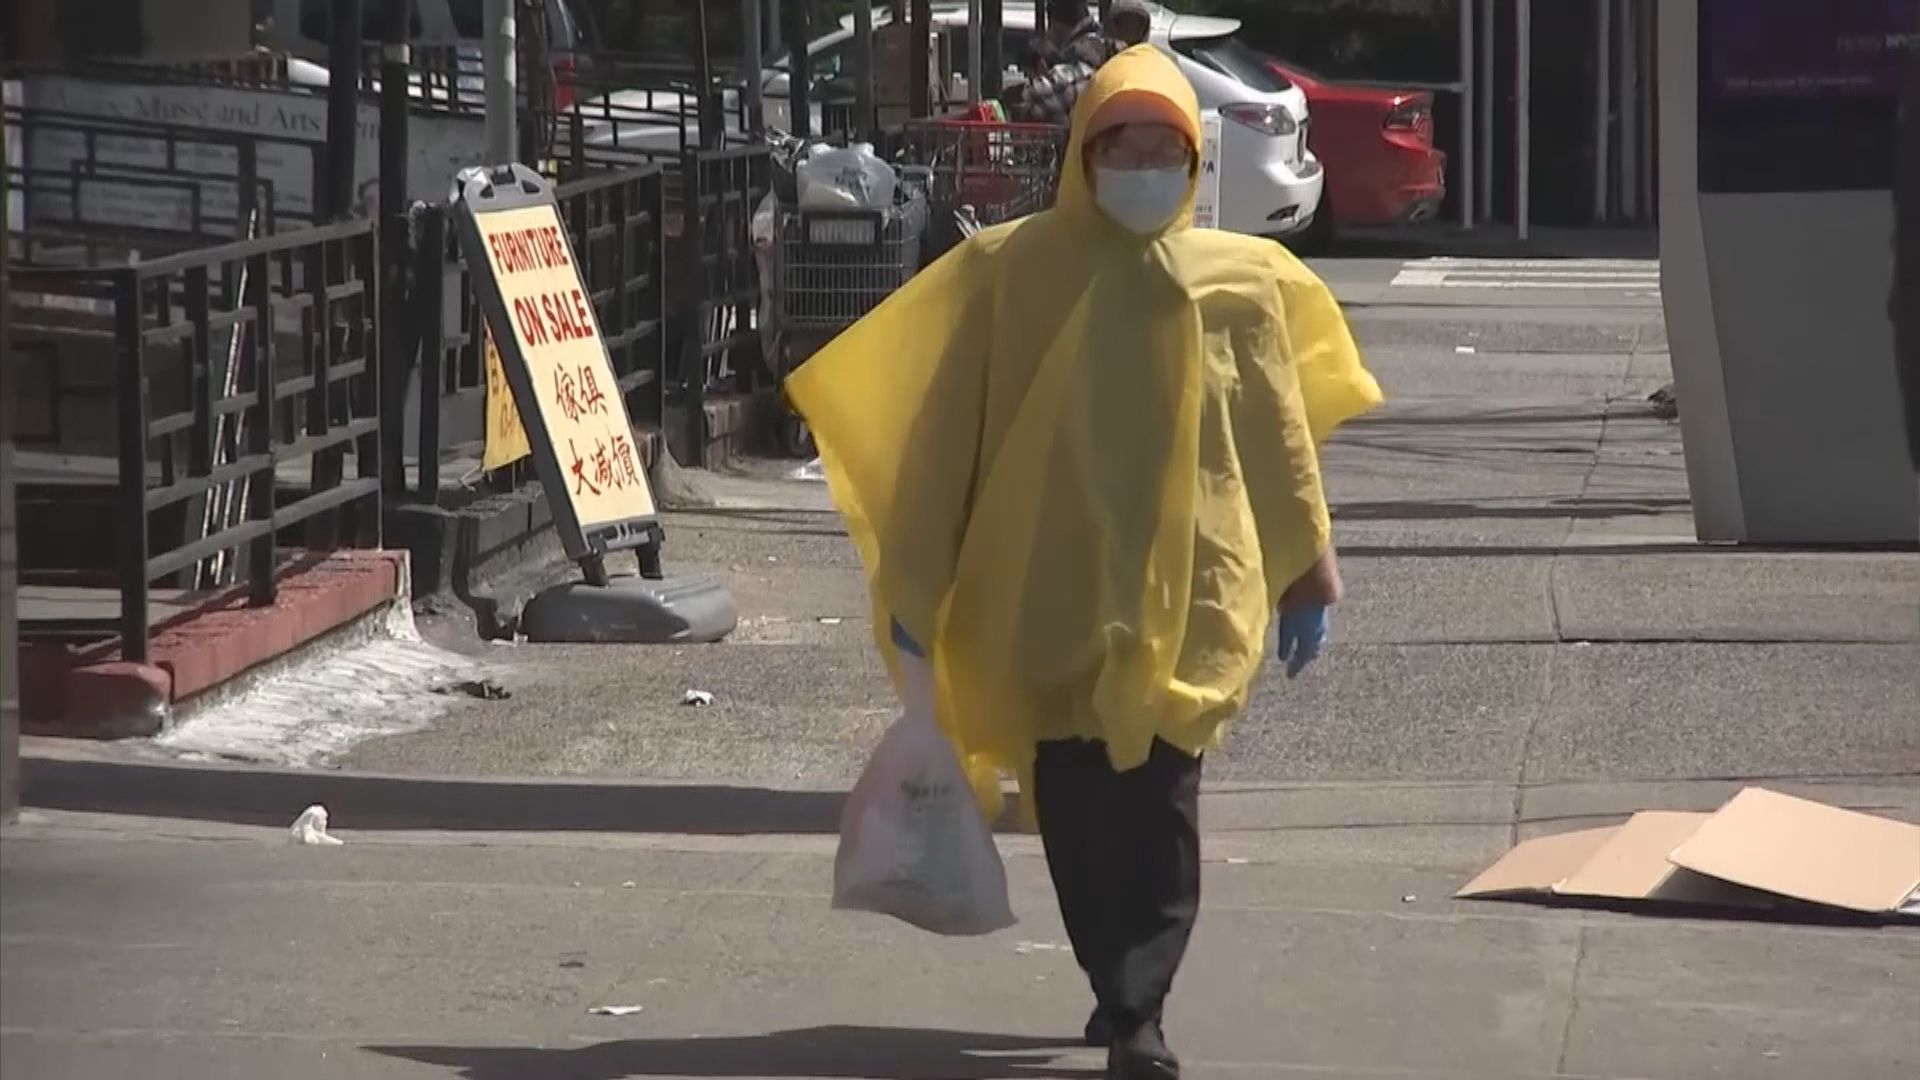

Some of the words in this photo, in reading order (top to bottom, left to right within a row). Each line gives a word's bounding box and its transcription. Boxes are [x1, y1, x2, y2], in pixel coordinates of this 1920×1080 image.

[215, 102, 260, 127] and
[275, 106, 321, 134] Arts
[488, 226, 568, 275] FURNITURE
[514, 297, 549, 347] ON
[541, 290, 593, 343] SALE
[553, 362, 608, 423] 傢俱
